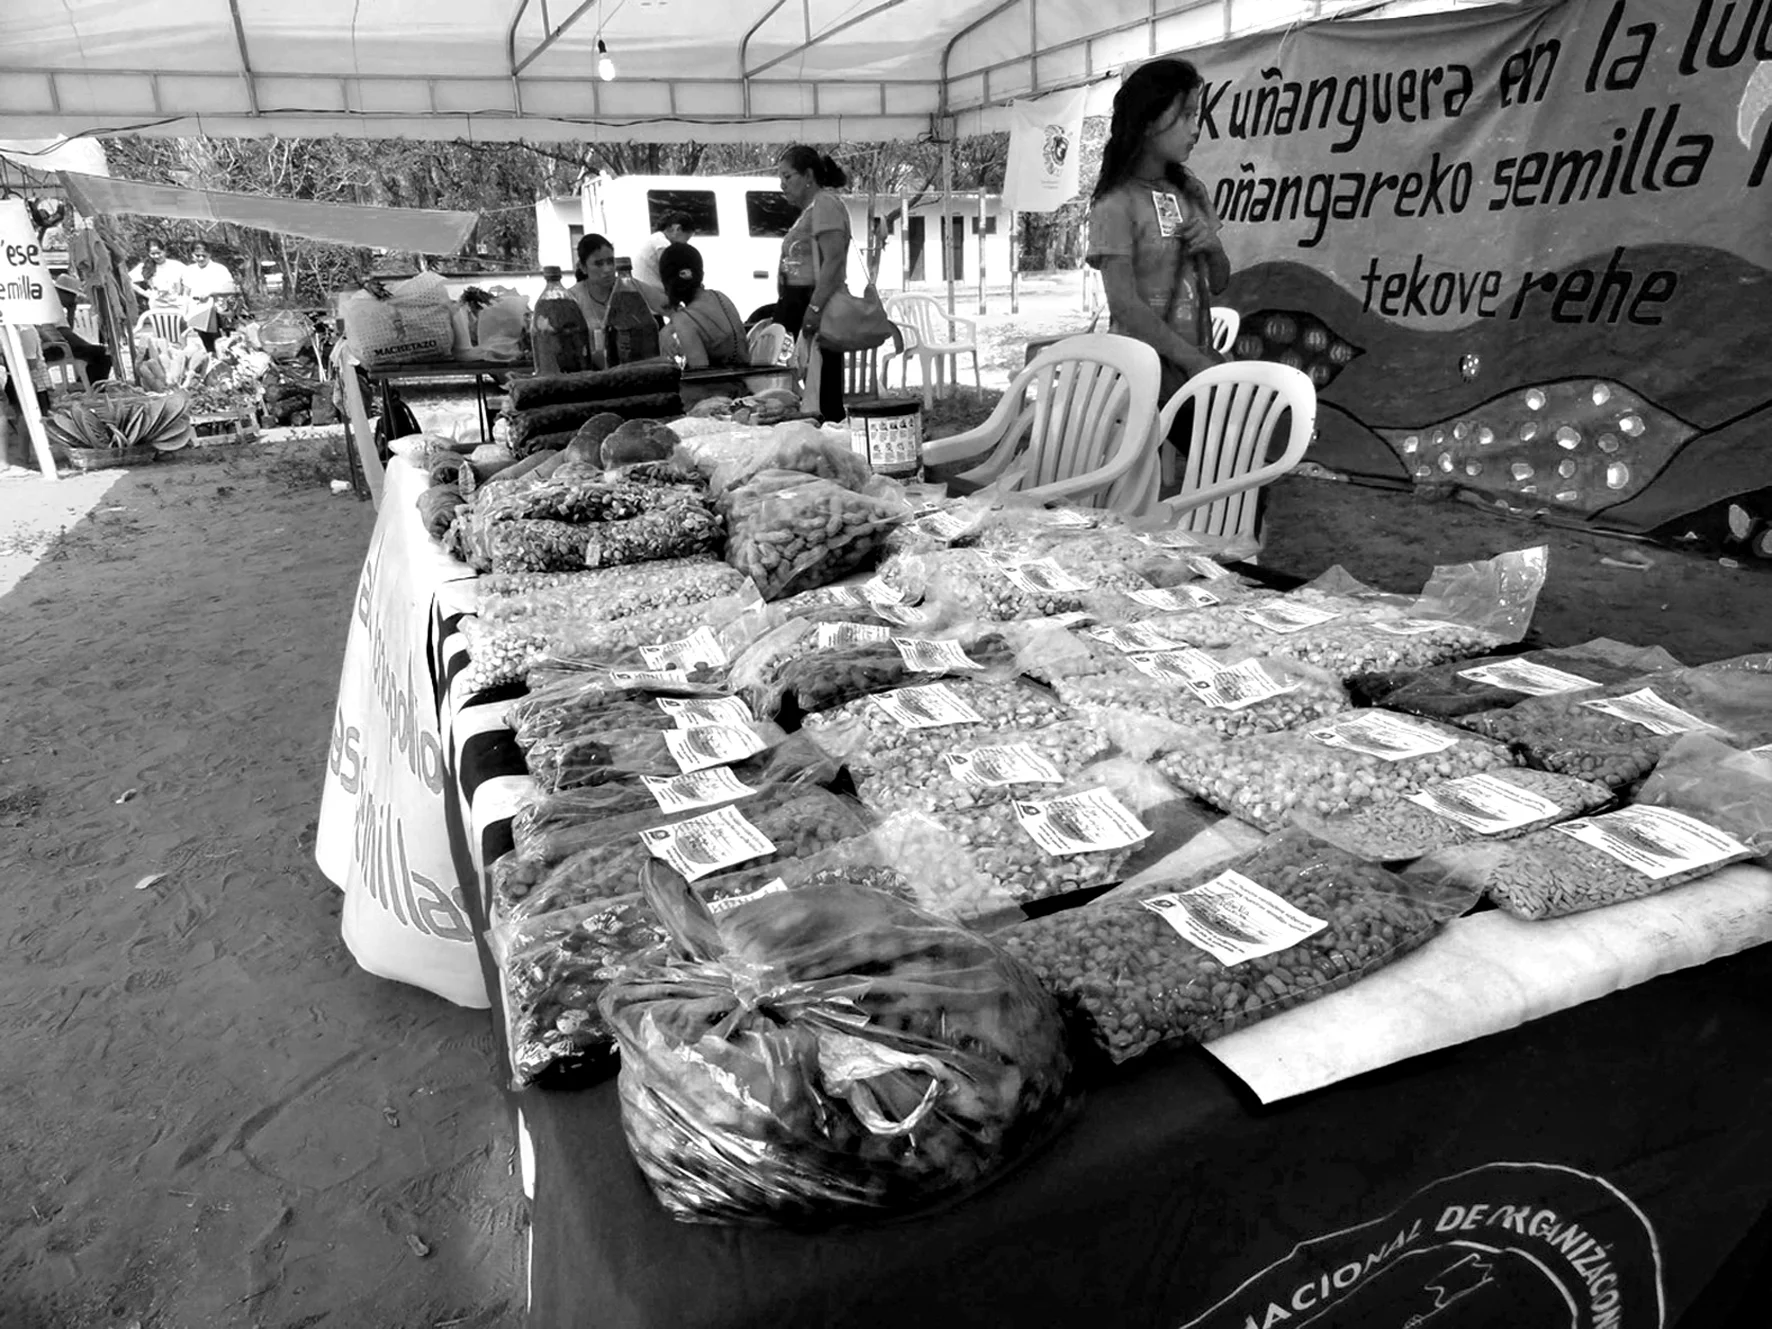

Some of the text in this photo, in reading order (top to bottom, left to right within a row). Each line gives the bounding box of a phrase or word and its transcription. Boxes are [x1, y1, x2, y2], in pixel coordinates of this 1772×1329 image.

[1197, 64, 1474, 153] Kuñanguera
[1500, 38, 1561, 109] en
[1585, 0, 1657, 93] la
[1489, 103, 1714, 211] semilla
[1361, 246, 1677, 326] tekove rehe
[1435, 1204, 1490, 1232] DE
